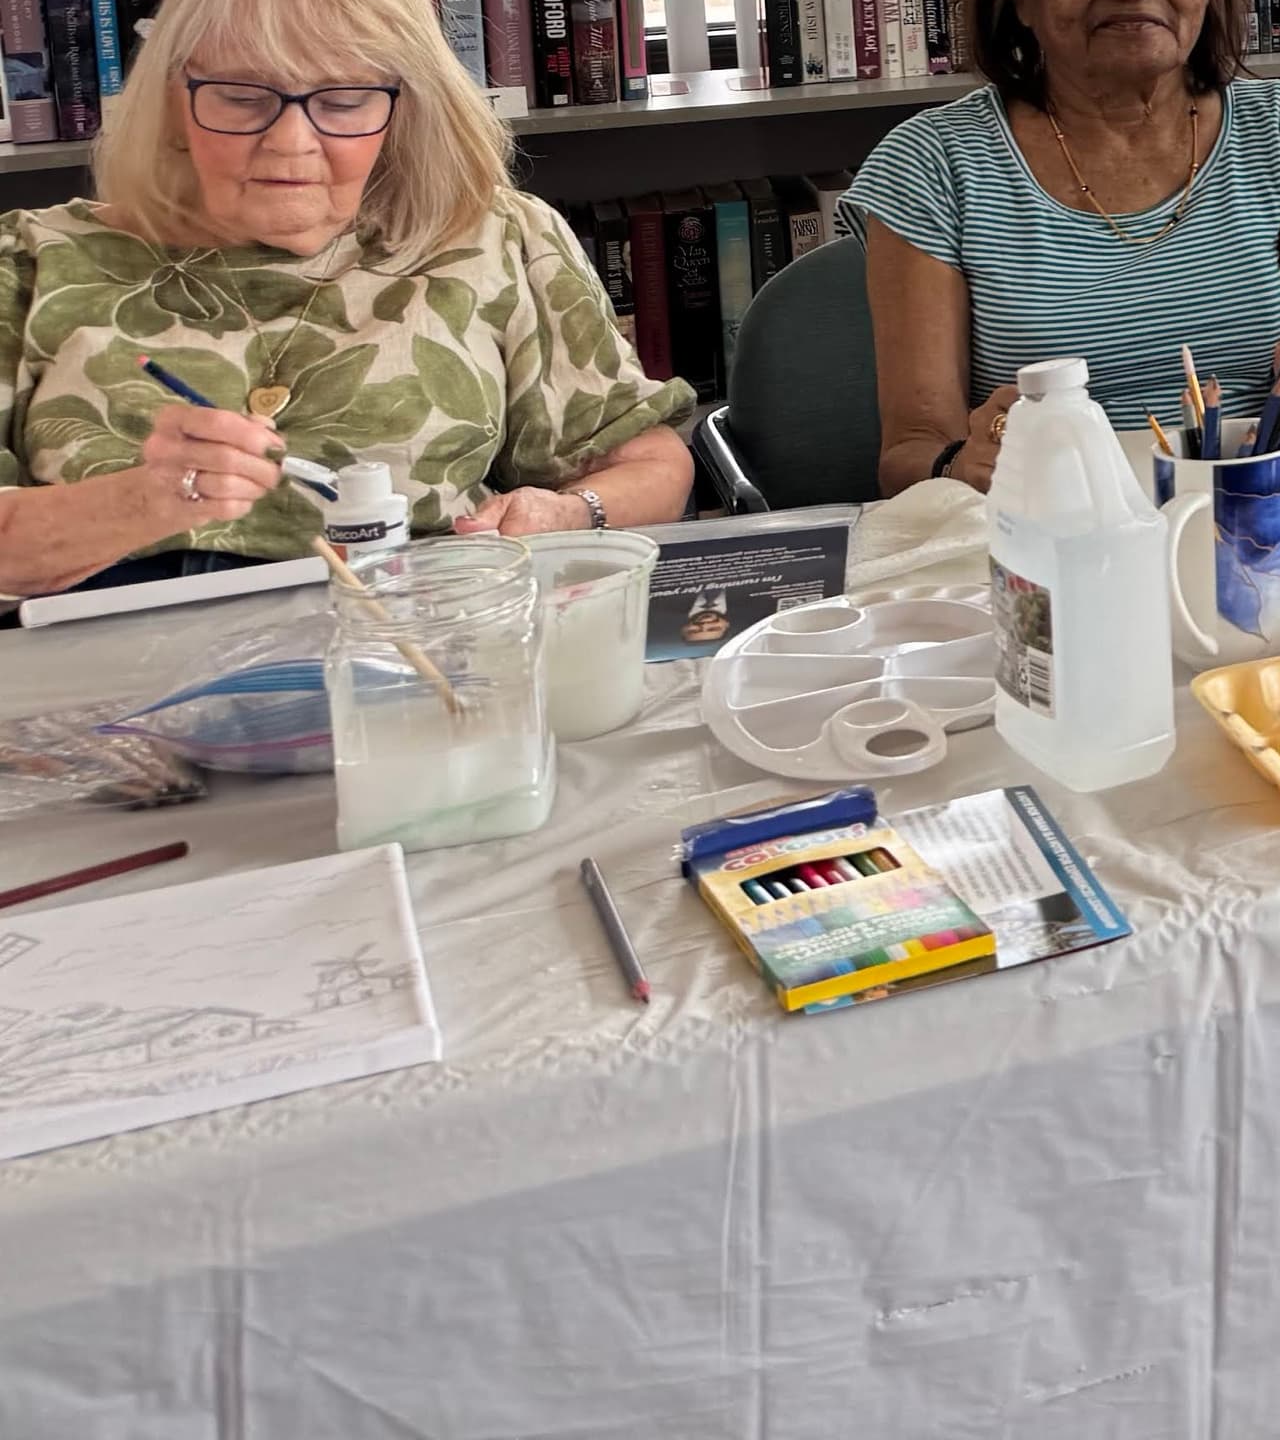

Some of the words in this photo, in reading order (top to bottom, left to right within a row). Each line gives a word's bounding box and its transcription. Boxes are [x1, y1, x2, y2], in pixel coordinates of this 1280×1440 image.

[100, 18, 113, 28] IS
[863, 3, 877, 31] LUCK
[864, 34, 878, 53] JOY
[930, 56, 950, 65] VHS
[329, 526, 381, 540] DecoArt
[682, 584, 704, 594] for
[705, 577, 760, 590] running
